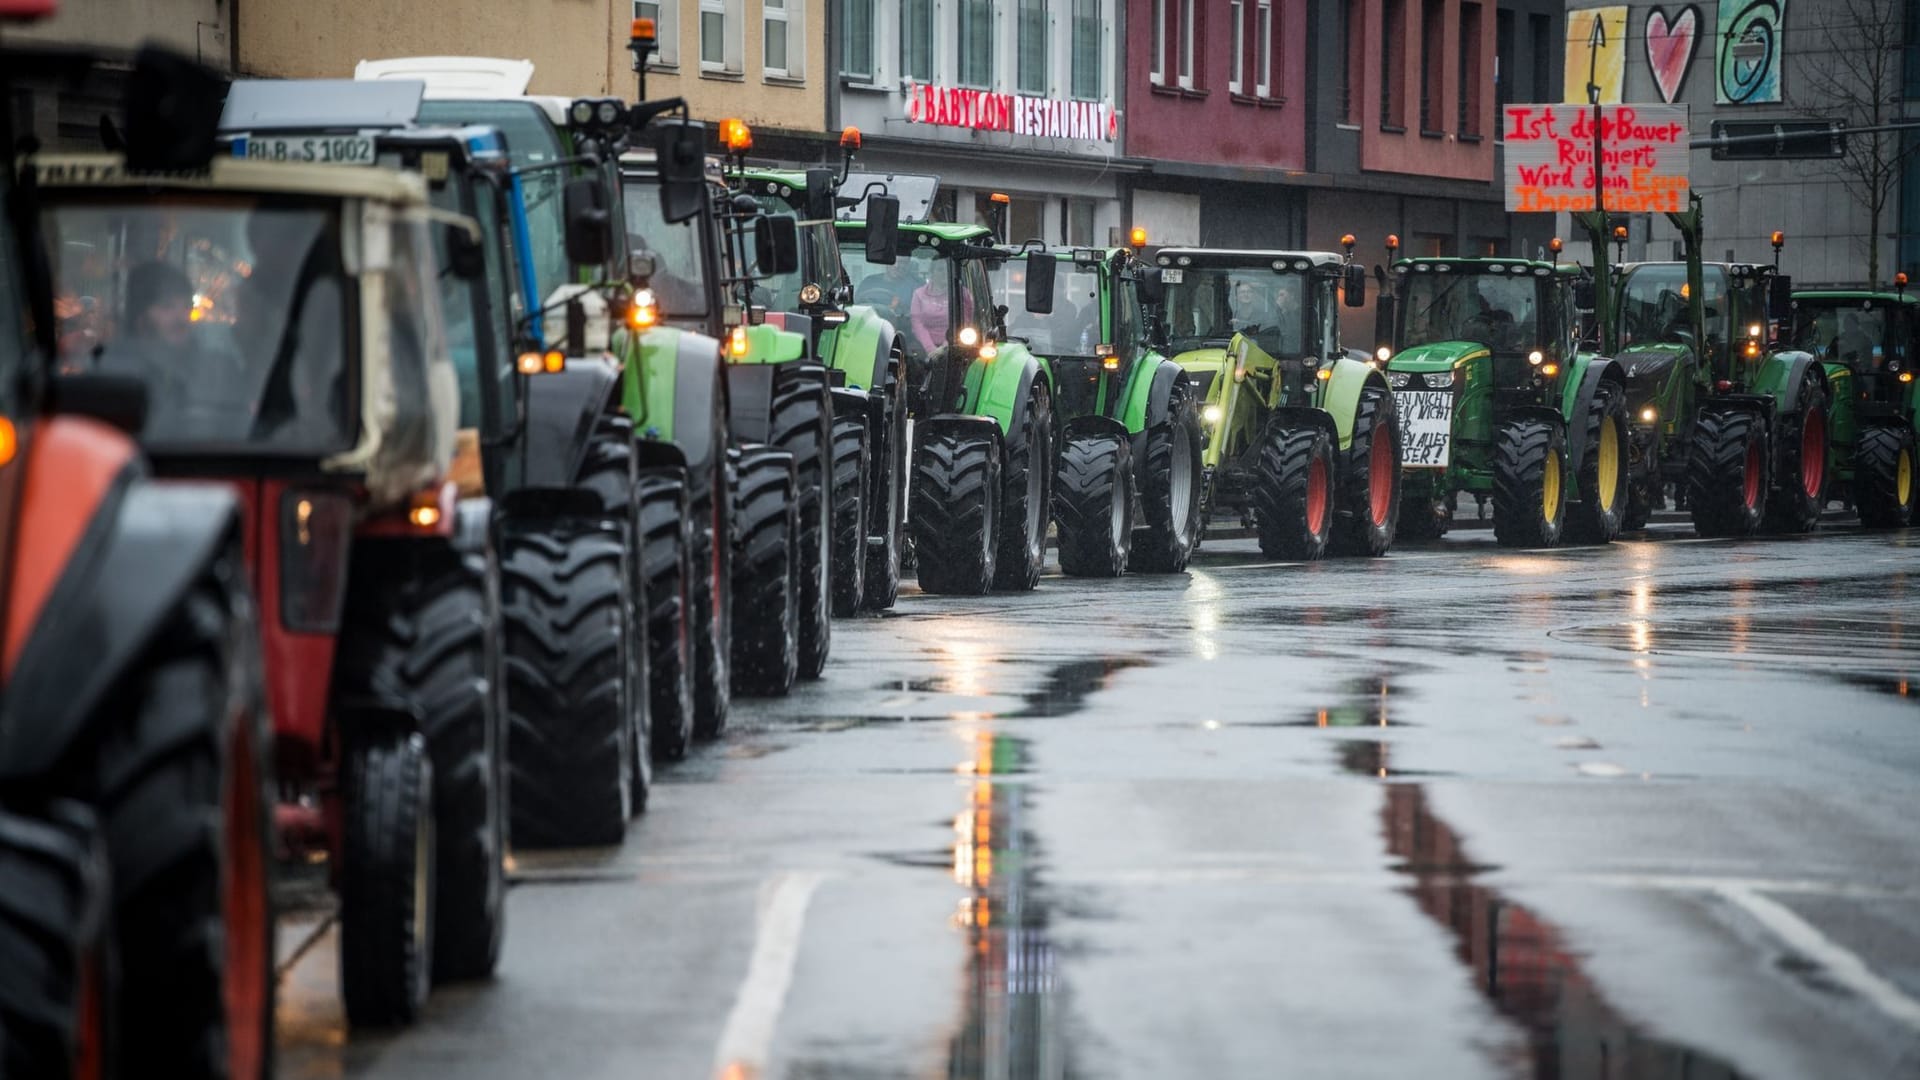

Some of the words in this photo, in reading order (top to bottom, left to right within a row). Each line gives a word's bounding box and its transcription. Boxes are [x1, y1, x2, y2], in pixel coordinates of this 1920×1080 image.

[924, 84, 1009, 131] BABYLON
[1013, 95, 1106, 140] RESTAURANT
[1505, 107, 1558, 140] Ist
[1616, 106, 1683, 143] Bauer
[1557, 138, 1656, 168] Ruiniert
[1518, 164, 1575, 190] Wird
[1395, 392, 1412, 405] EN
[1414, 391, 1454, 407] NICHT
[1396, 405, 1415, 420] EN
[1417, 405, 1452, 421] NICHT
[1400, 432, 1416, 447] EN
[1416, 432, 1450, 448] ALLES
